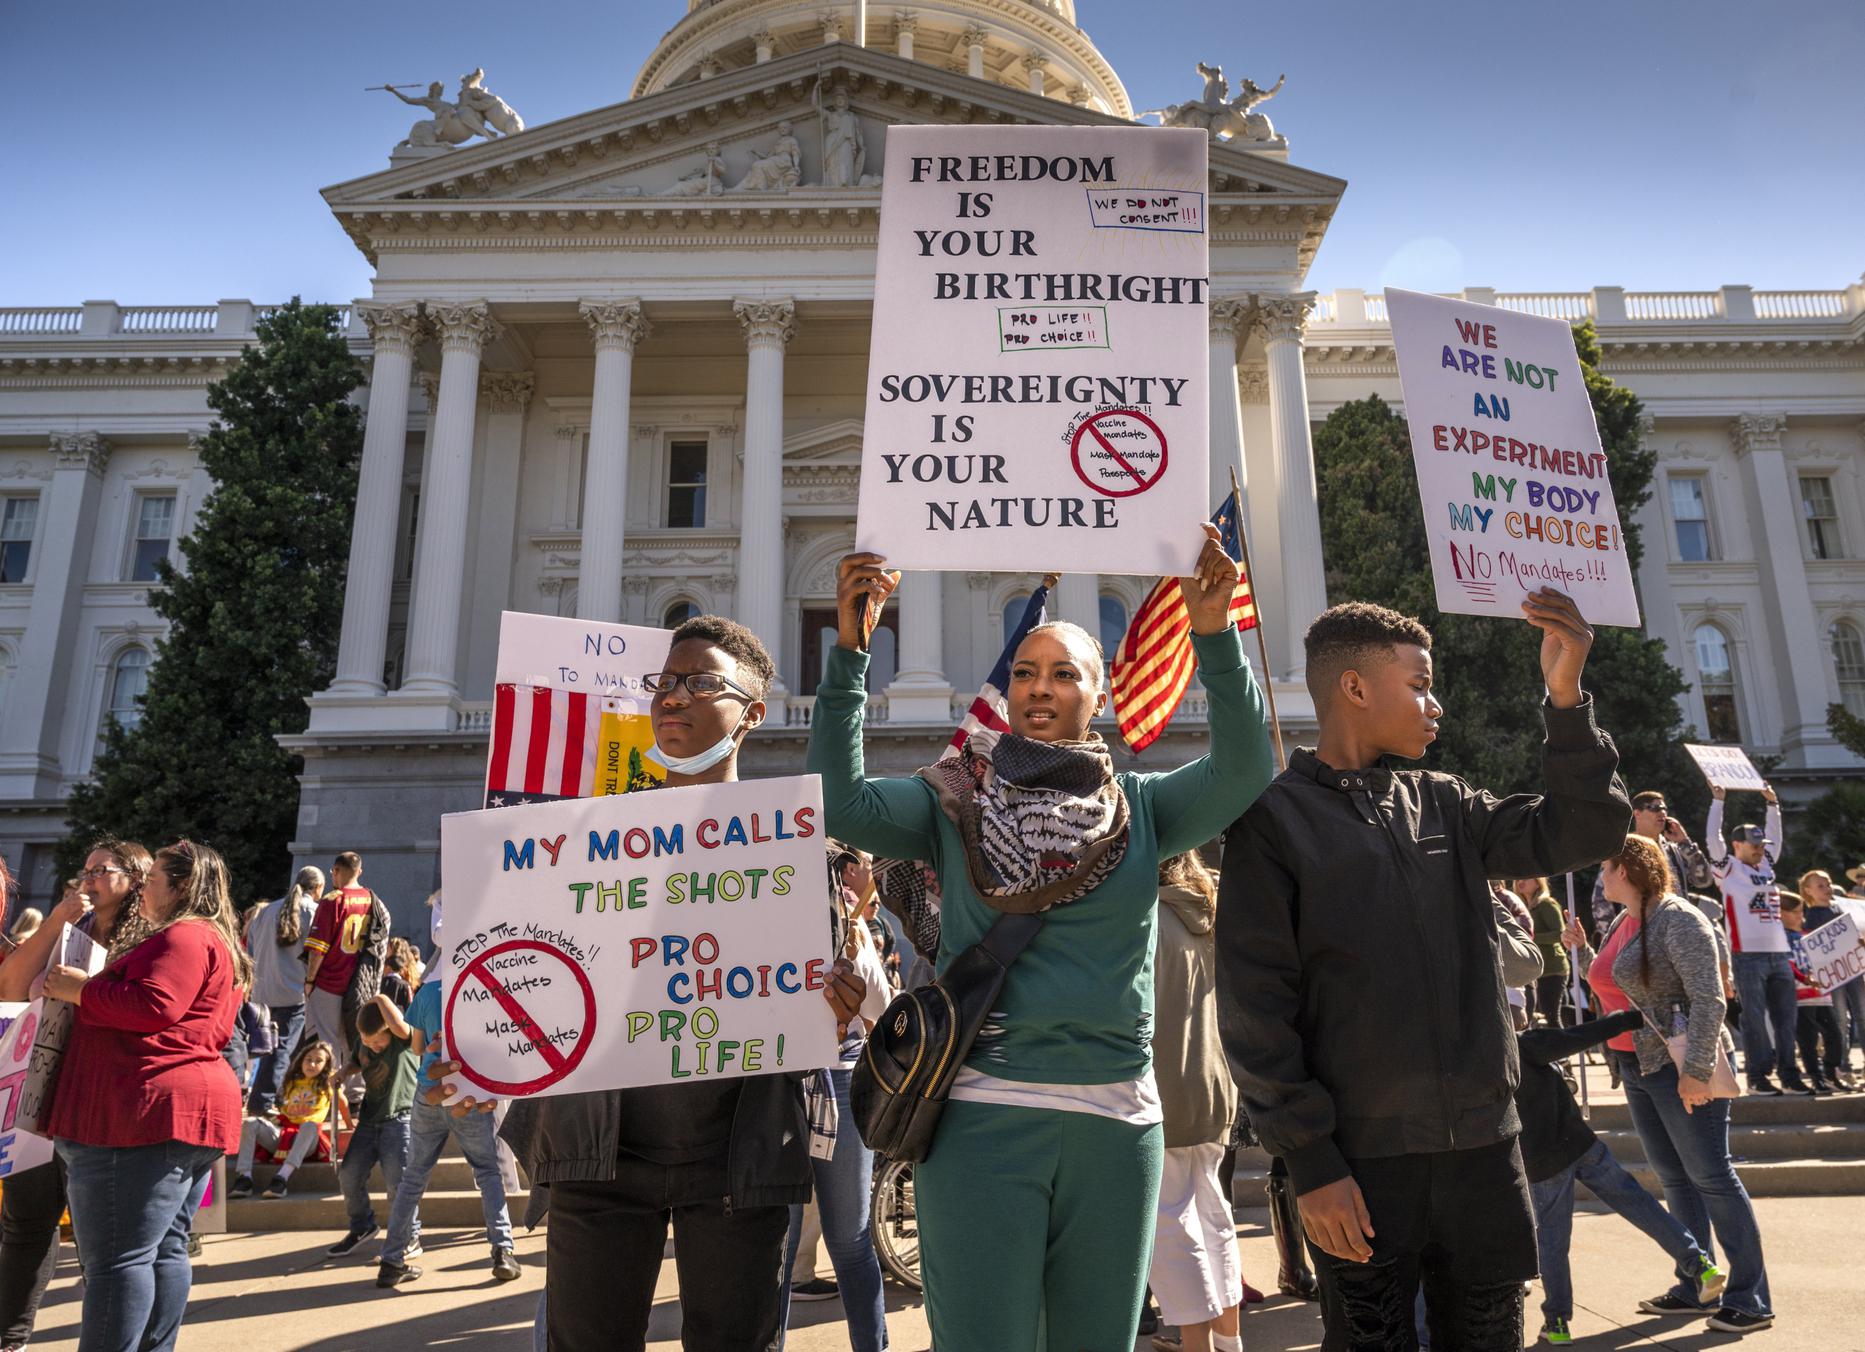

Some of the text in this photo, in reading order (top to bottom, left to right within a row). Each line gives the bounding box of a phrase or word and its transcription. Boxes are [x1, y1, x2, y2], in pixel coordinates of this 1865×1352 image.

[909, 155, 1117, 183] FREEDOM
[955, 192, 994, 219] IS
[1095, 197, 1179, 210] WE DO NOT
[913, 229, 1038, 257] YOUR
[934, 272, 1209, 305] BIRTHRIGHT
[1011, 314, 1038, 326] PRO
[1455, 318, 1498, 349] WE
[1004, 333, 1030, 345] PRO
[1441, 345, 1559, 392] ARE NOT
[879, 374, 1189, 407] SOVEREIGNTY
[1473, 392, 1511, 422] AN
[930, 413, 975, 444] IS
[881, 453, 1009, 484] YOUR
[1432, 425, 1606, 479] EXPERIMENT
[1472, 471, 1601, 515] MY BODY
[925, 497, 1119, 531] NATURE
[1448, 502, 1620, 551] MY CHOICE!
[1450, 540, 1492, 581] NO
[584, 633, 626, 657] NO
[607, 741, 620, 774] DONT
[503, 806, 815, 872] MY MOM CALLS
[568, 865, 793, 914] THE SHOTS
[452, 933, 488, 969] STOP
[489, 921, 518, 940] The
[629, 932, 720, 969] PRO
[486, 952, 538, 973] Vaccine
[1817, 946, 1865, 989] CHOICE
[462, 975, 552, 1003] Mandates
[666, 958, 825, 1005] CHOICE
[485, 1015, 531, 1038] Mask
[625, 1005, 720, 1044] PRO
[508, 1026, 580, 1057] Mandates
[670, 1033, 785, 1079] LIFE!
